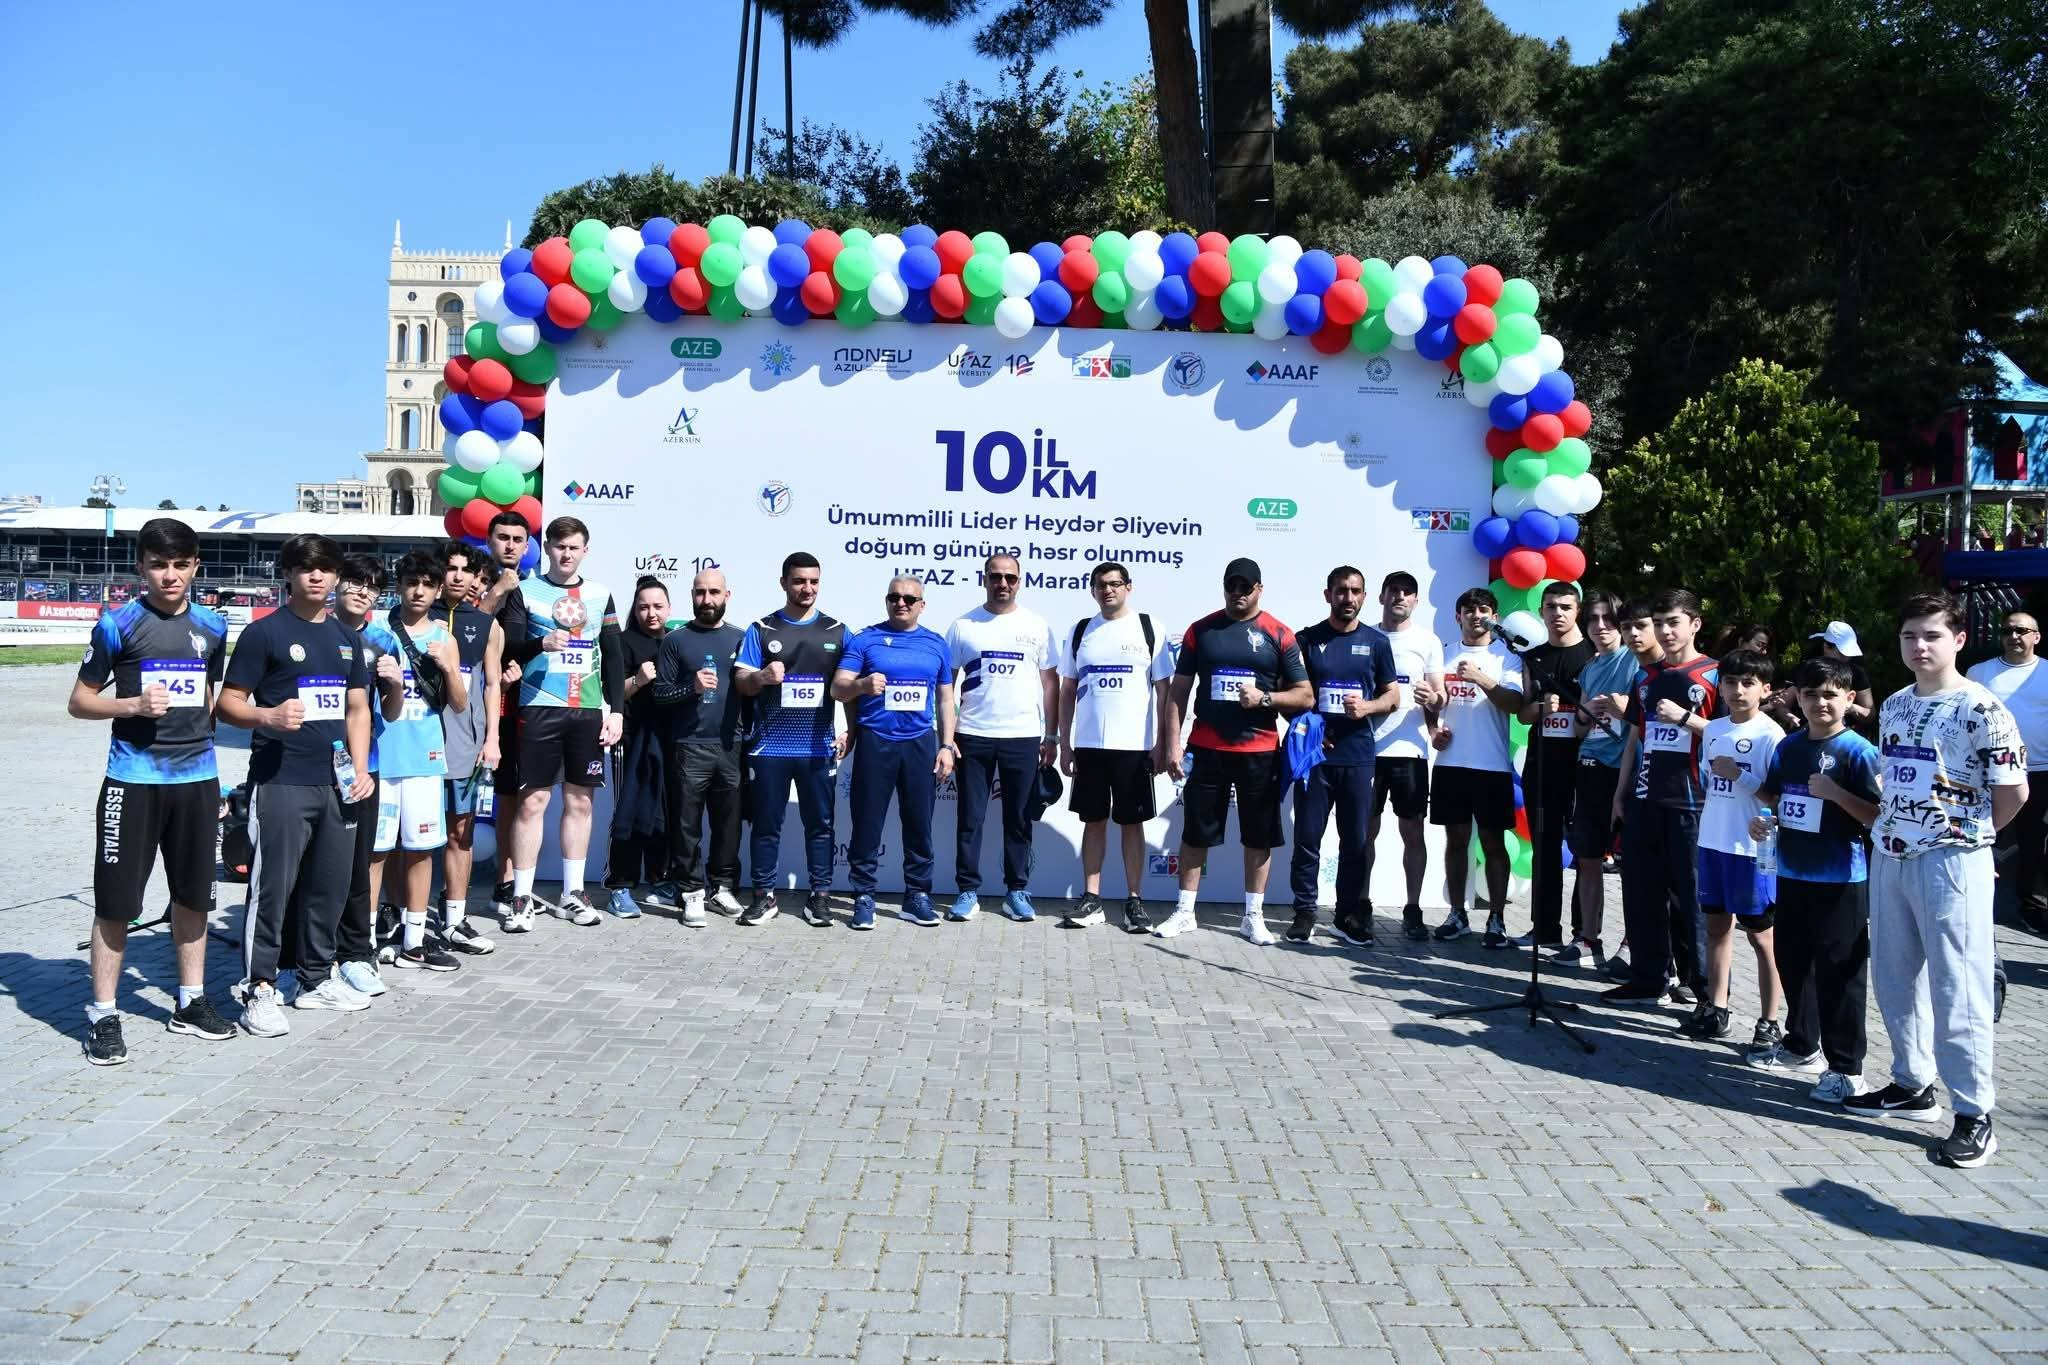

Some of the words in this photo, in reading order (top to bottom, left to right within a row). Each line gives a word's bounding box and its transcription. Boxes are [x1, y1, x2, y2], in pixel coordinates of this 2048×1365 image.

[680, 341, 713, 355] AZE
[834, 363, 863, 372] AZIU
[1268, 364, 1319, 380] AAAF
[1435, 391, 1465, 399] AZERS
[663, 436, 701, 444] AZERSUN
[935, 430, 1027, 494] 10
[585, 483, 635, 499] AAAF
[1032, 469, 1096, 499] KM
[1256, 502, 1289, 516] AZE
[828, 504, 953, 528] Ümummilli
[961, 511, 1017, 530] Lider
[1025, 514, 1105, 535] Heydər
[1112, 516, 1202, 538] Əliyevin
[845, 537, 926, 559] doğum
[1028, 543, 1077, 561] həsr
[1084, 544, 1183, 568] olunmuş
[560, 653, 583, 665] 125
[988, 663, 1016, 675] 007
[1099, 678, 1123, 689] 001
[792, 688, 815, 699] 165
[893, 691, 921, 703] 009
[1451, 686, 1477, 698] 054
[315, 694, 340, 708] 153
[1544, 718, 1569, 729] 060
[1654, 728, 1679, 742] 179
[1893, 765, 1917, 783] 169
[1713, 777, 1733, 792] 131
[1783, 801, 1807, 819] 133
[104, 786, 124, 865] ESSENTIALS
